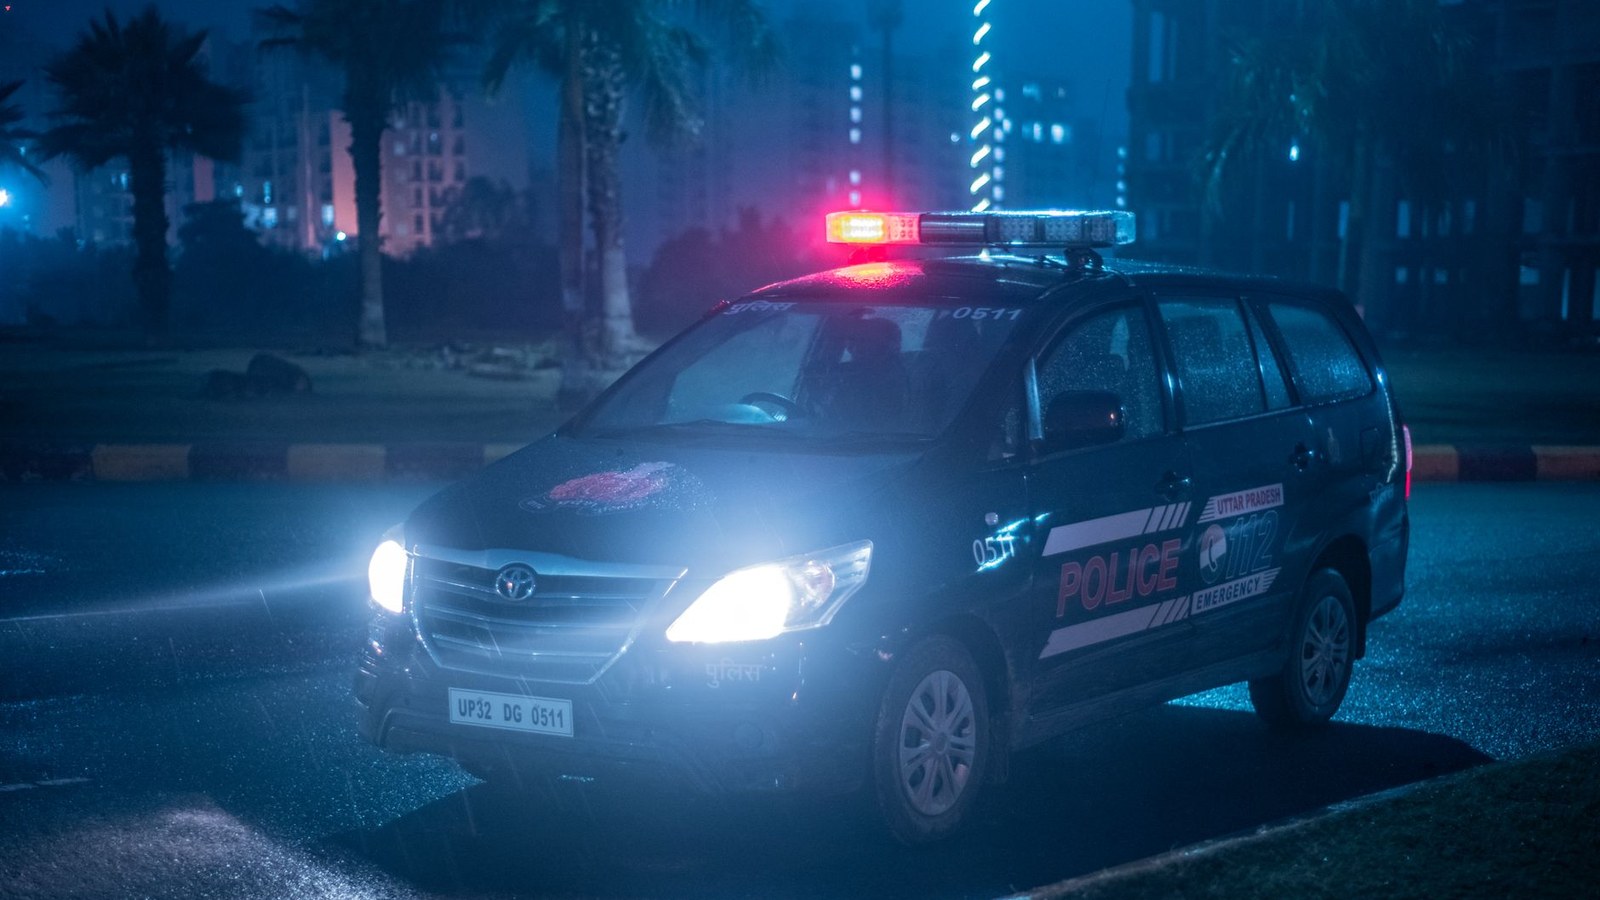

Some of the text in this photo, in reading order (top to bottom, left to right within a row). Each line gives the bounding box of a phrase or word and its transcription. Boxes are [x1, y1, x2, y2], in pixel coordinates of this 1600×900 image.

[723, 299, 798, 315] पुलिस
[952, 306, 1023, 320] 0511
[1216, 487, 1282, 515] UTTAR PRADESH
[972, 532, 1016, 567] 0511
[1225, 509, 1280, 580] 112
[1055, 538, 1182, 618] POLICE
[1196, 579, 1261, 610] EMERGENCY
[705, 657, 764, 689] पुलिस
[458, 697, 564, 728] UP32 DG 0511
